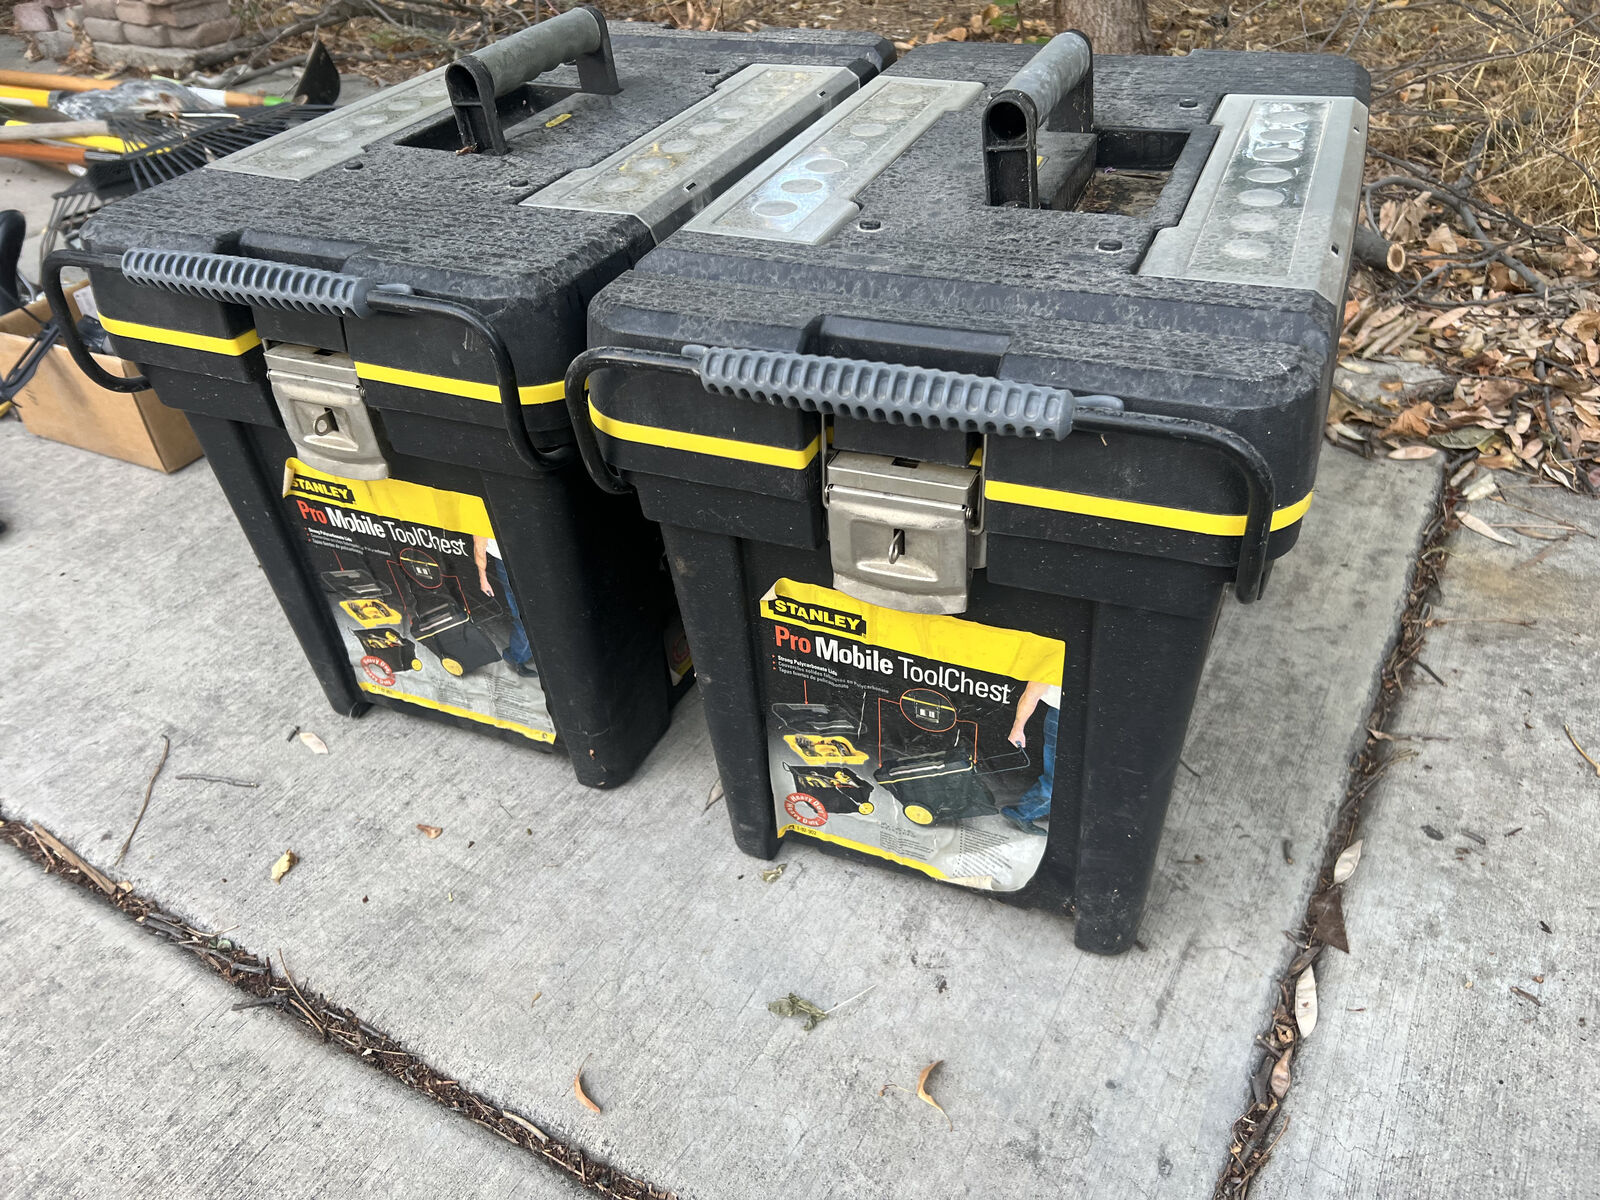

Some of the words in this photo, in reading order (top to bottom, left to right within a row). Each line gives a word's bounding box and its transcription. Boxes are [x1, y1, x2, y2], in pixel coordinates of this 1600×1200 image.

[296, 500, 328, 525] Pro
[325, 506, 387, 539] Mobile
[382, 520, 469, 557] ToolChest
[775, 599, 860, 631] STANLEY
[775, 625, 812, 654] Pro
[815, 636, 894, 676] Mobile
[898, 656, 1010, 705] ToolChest
[778, 655, 793, 665] Strong
[794, 659, 827, 673] Polycarbonate
[828, 668, 838, 677] Lids
[779, 666, 792, 675] Tapas
